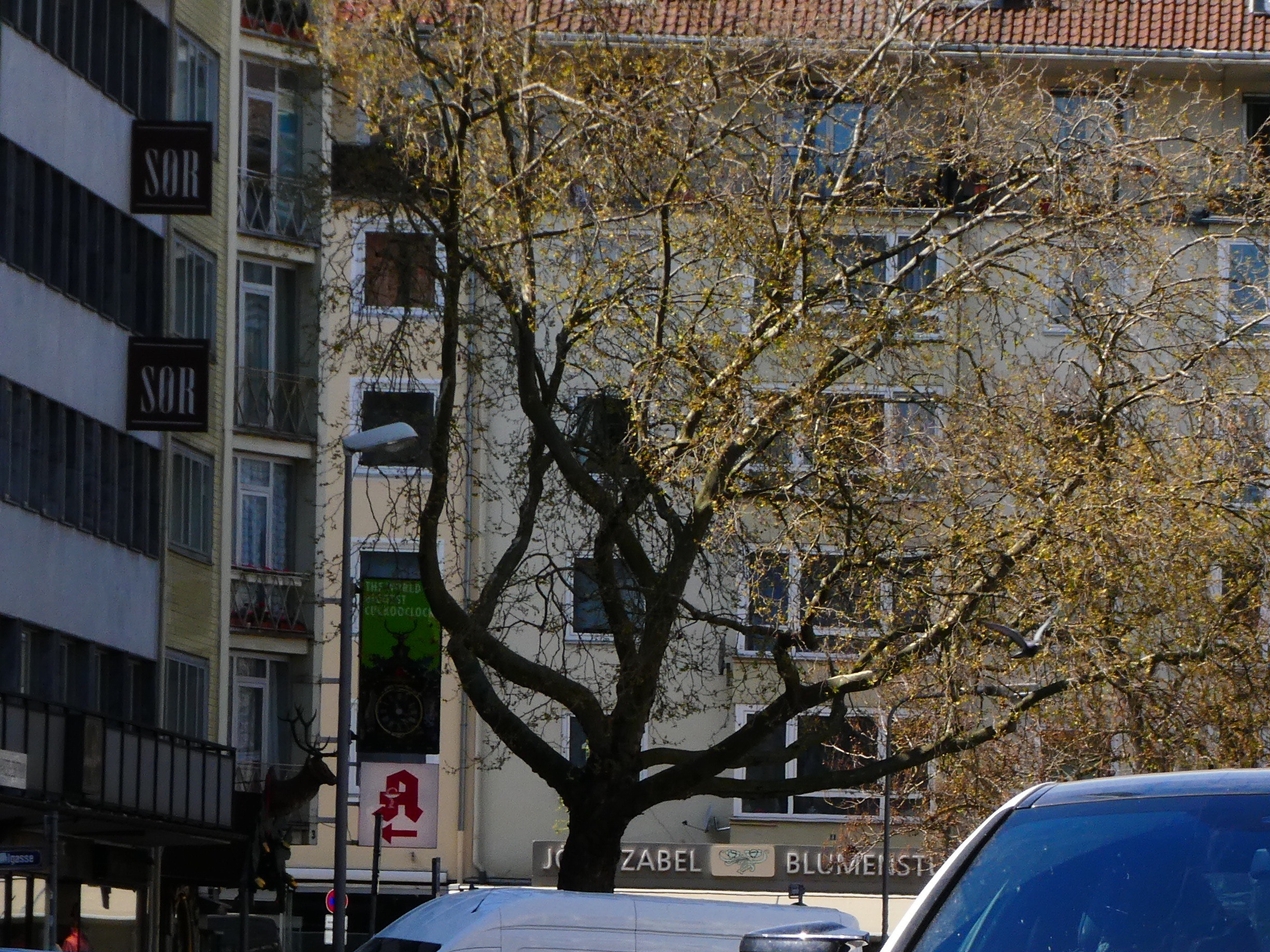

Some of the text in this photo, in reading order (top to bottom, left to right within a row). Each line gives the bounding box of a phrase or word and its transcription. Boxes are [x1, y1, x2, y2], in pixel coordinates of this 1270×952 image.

[144, 148, 199, 198] SOR
[140, 365, 195, 415] SOR
[365, 581, 383, 592] THE
[620, 848, 702, 873] ZABEL
